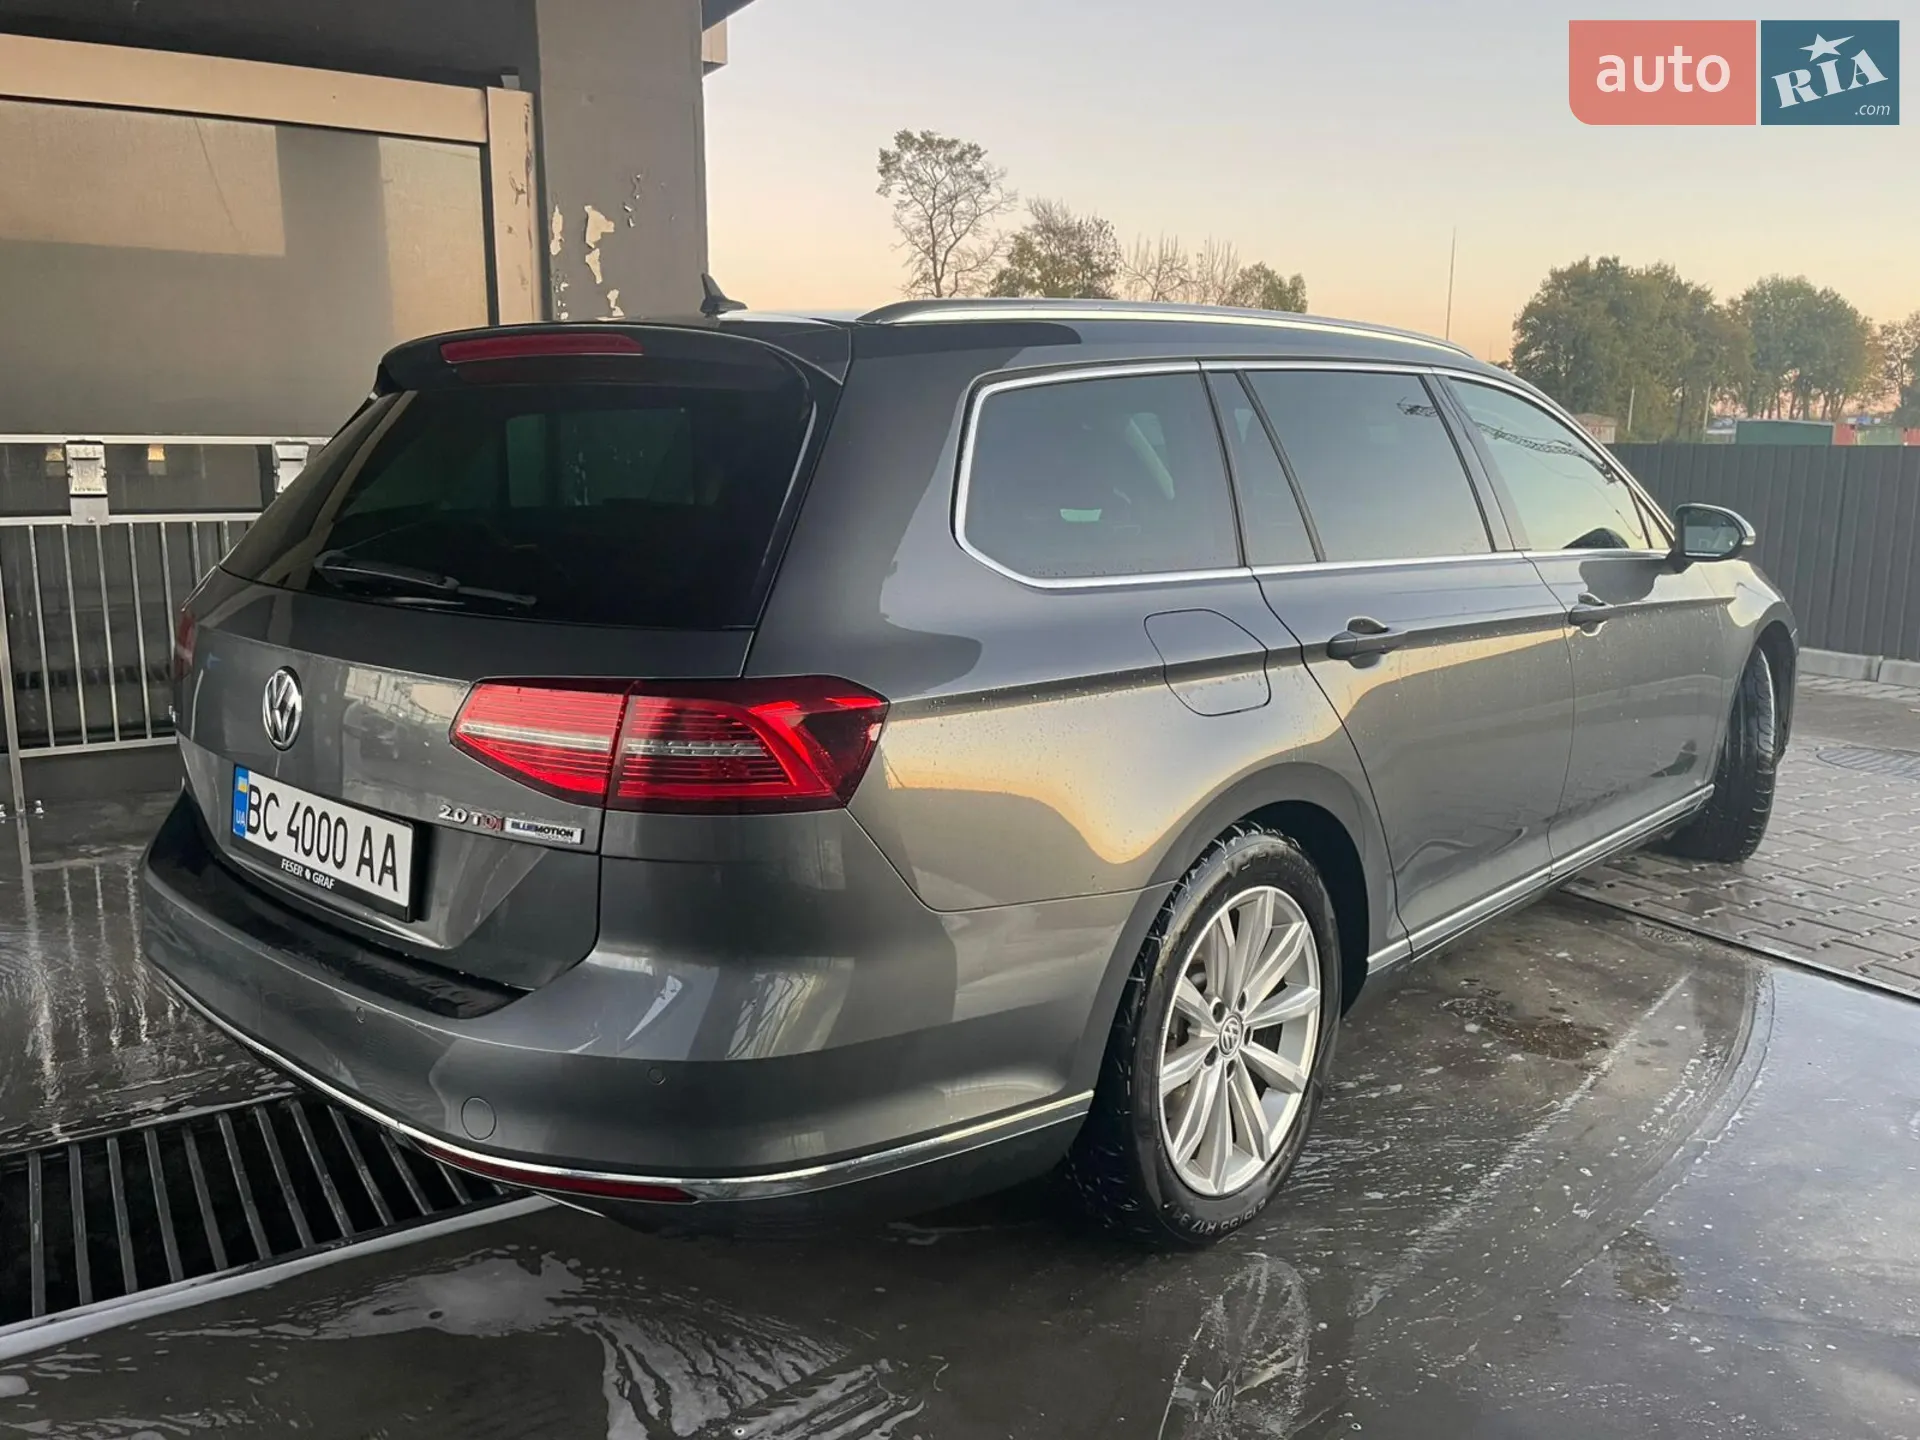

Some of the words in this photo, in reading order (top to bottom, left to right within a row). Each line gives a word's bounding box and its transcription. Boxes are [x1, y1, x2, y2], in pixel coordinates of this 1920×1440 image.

[235, 809, 246, 829] UA
[247, 784, 280, 842] BC
[286, 801, 348, 870] 4000
[355, 825, 399, 893] AA
[280, 858, 303, 878] FESER
[312, 871, 336, 891] GRAF
